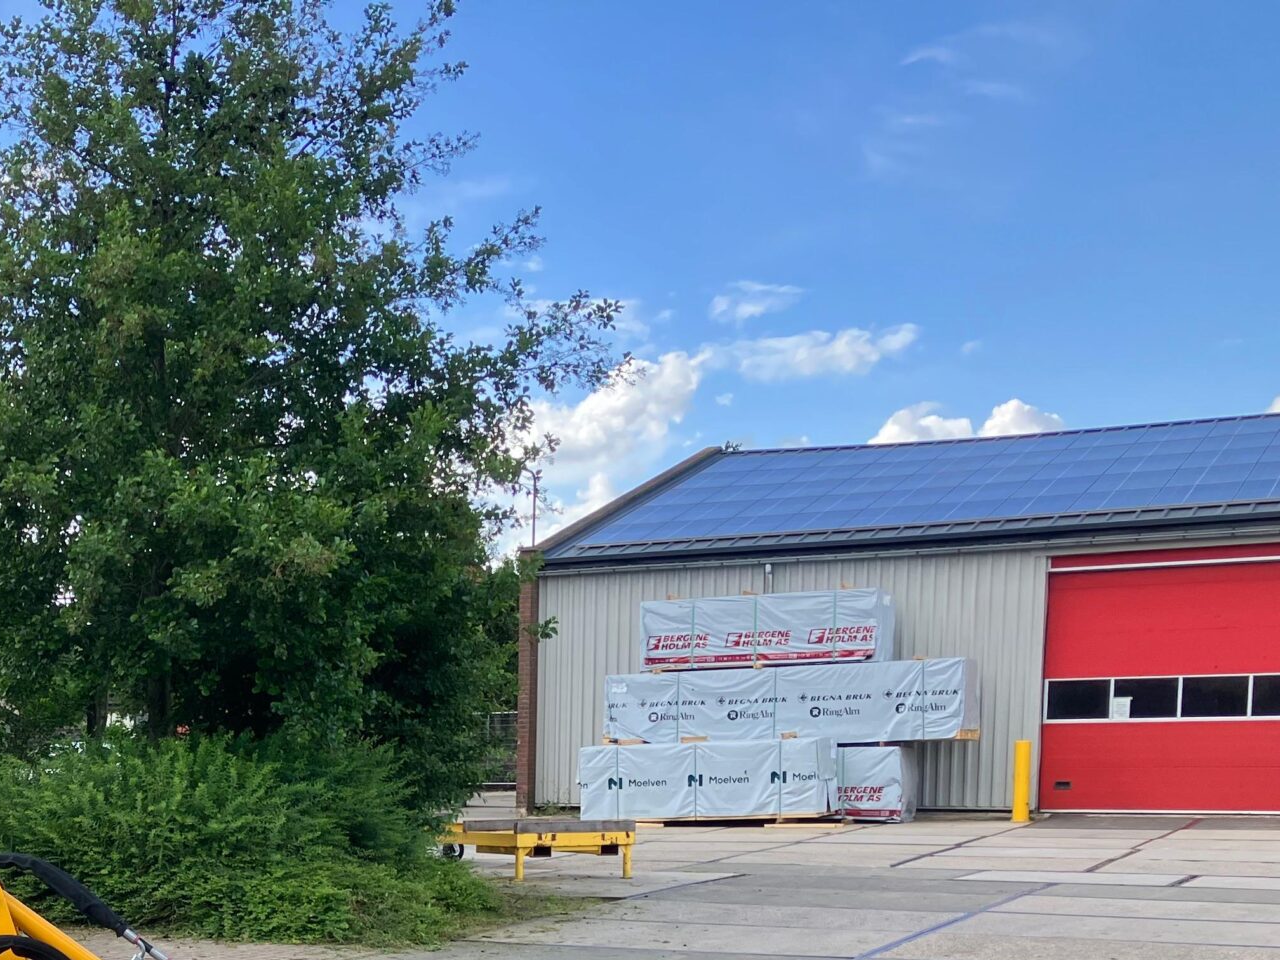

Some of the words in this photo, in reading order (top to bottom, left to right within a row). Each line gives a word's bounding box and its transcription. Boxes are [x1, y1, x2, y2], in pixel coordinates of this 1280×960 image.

[661, 642, 691, 650] HOLM
[694, 641, 708, 649] AS
[775, 638, 789, 646] AS
[822, 706, 860, 717] RingAlm
[628, 778, 667, 788] Moelven
[708, 775, 749, 785] Moelven
[866, 794, 882, 802] AS
